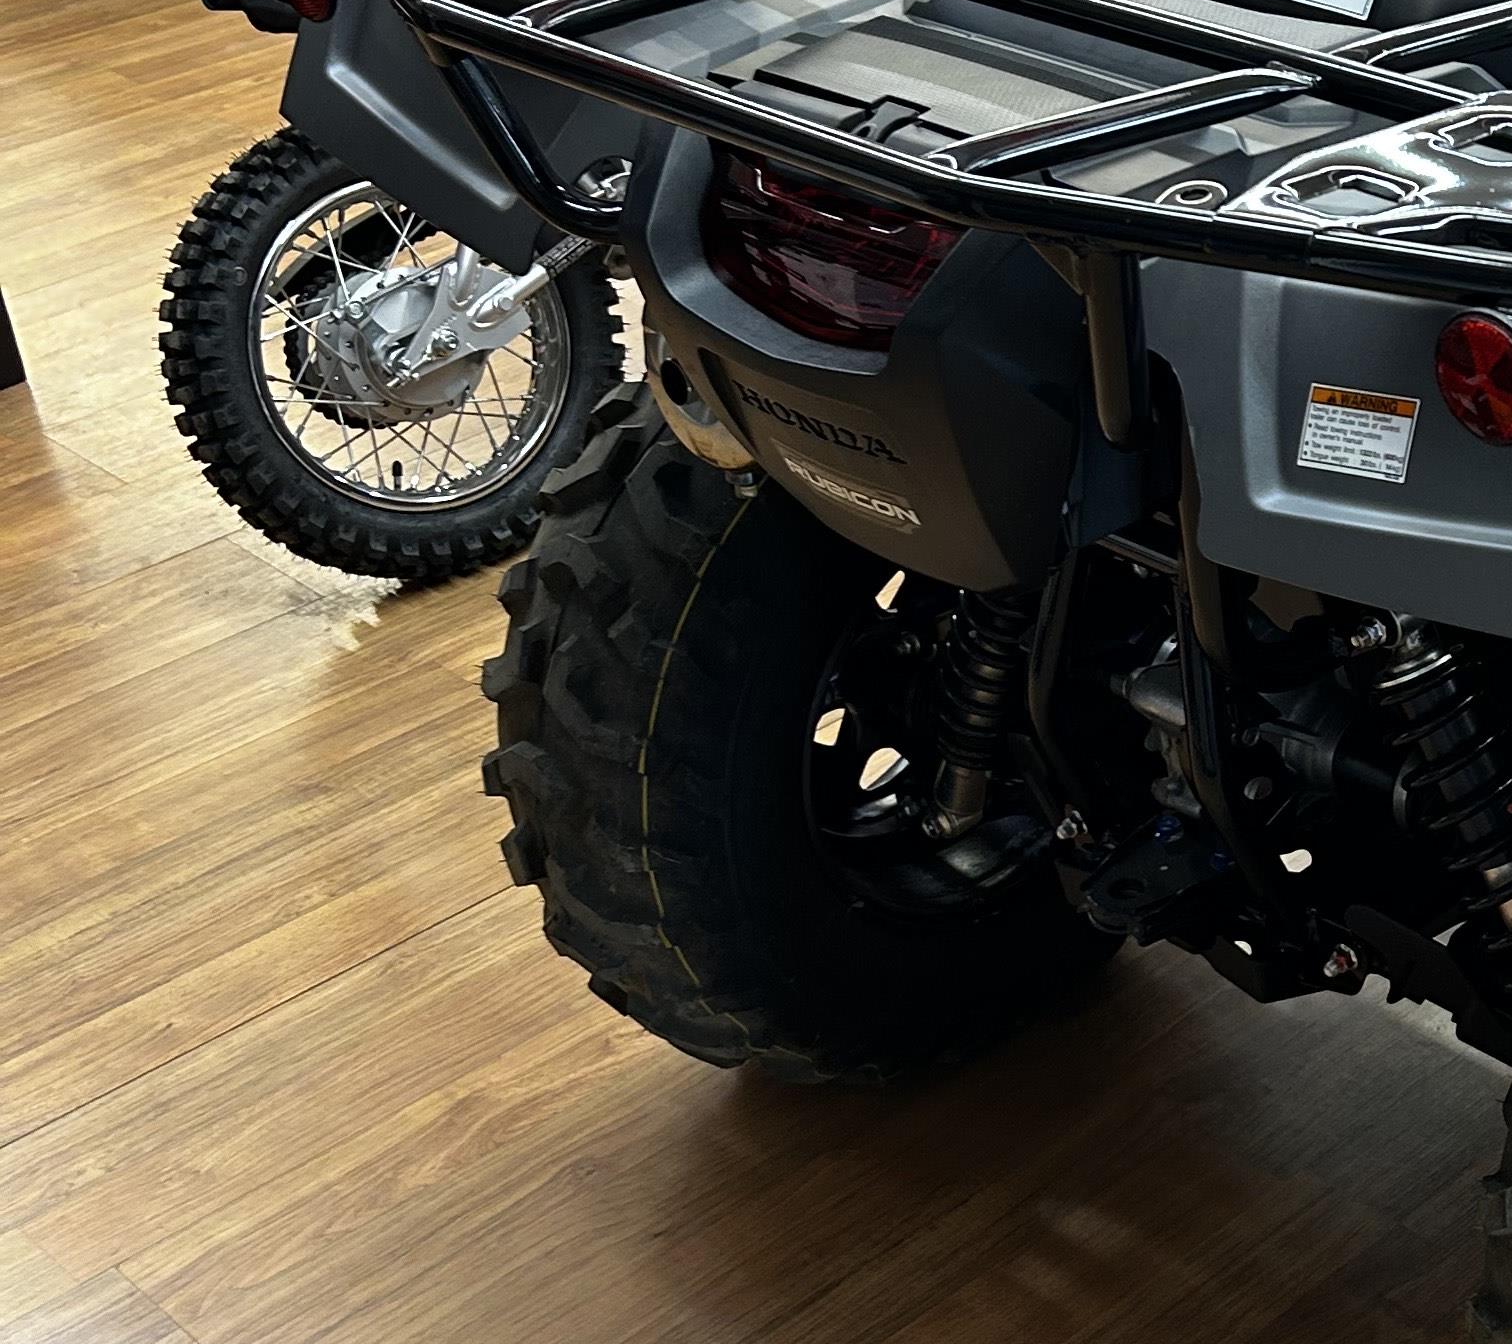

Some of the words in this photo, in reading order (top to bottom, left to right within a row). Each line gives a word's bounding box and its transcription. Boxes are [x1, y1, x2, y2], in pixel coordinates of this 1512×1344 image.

[733, 378, 908, 465] HONDA
[1340, 393, 1399, 413] WARNING
[782, 456, 922, 526] RUBICON
